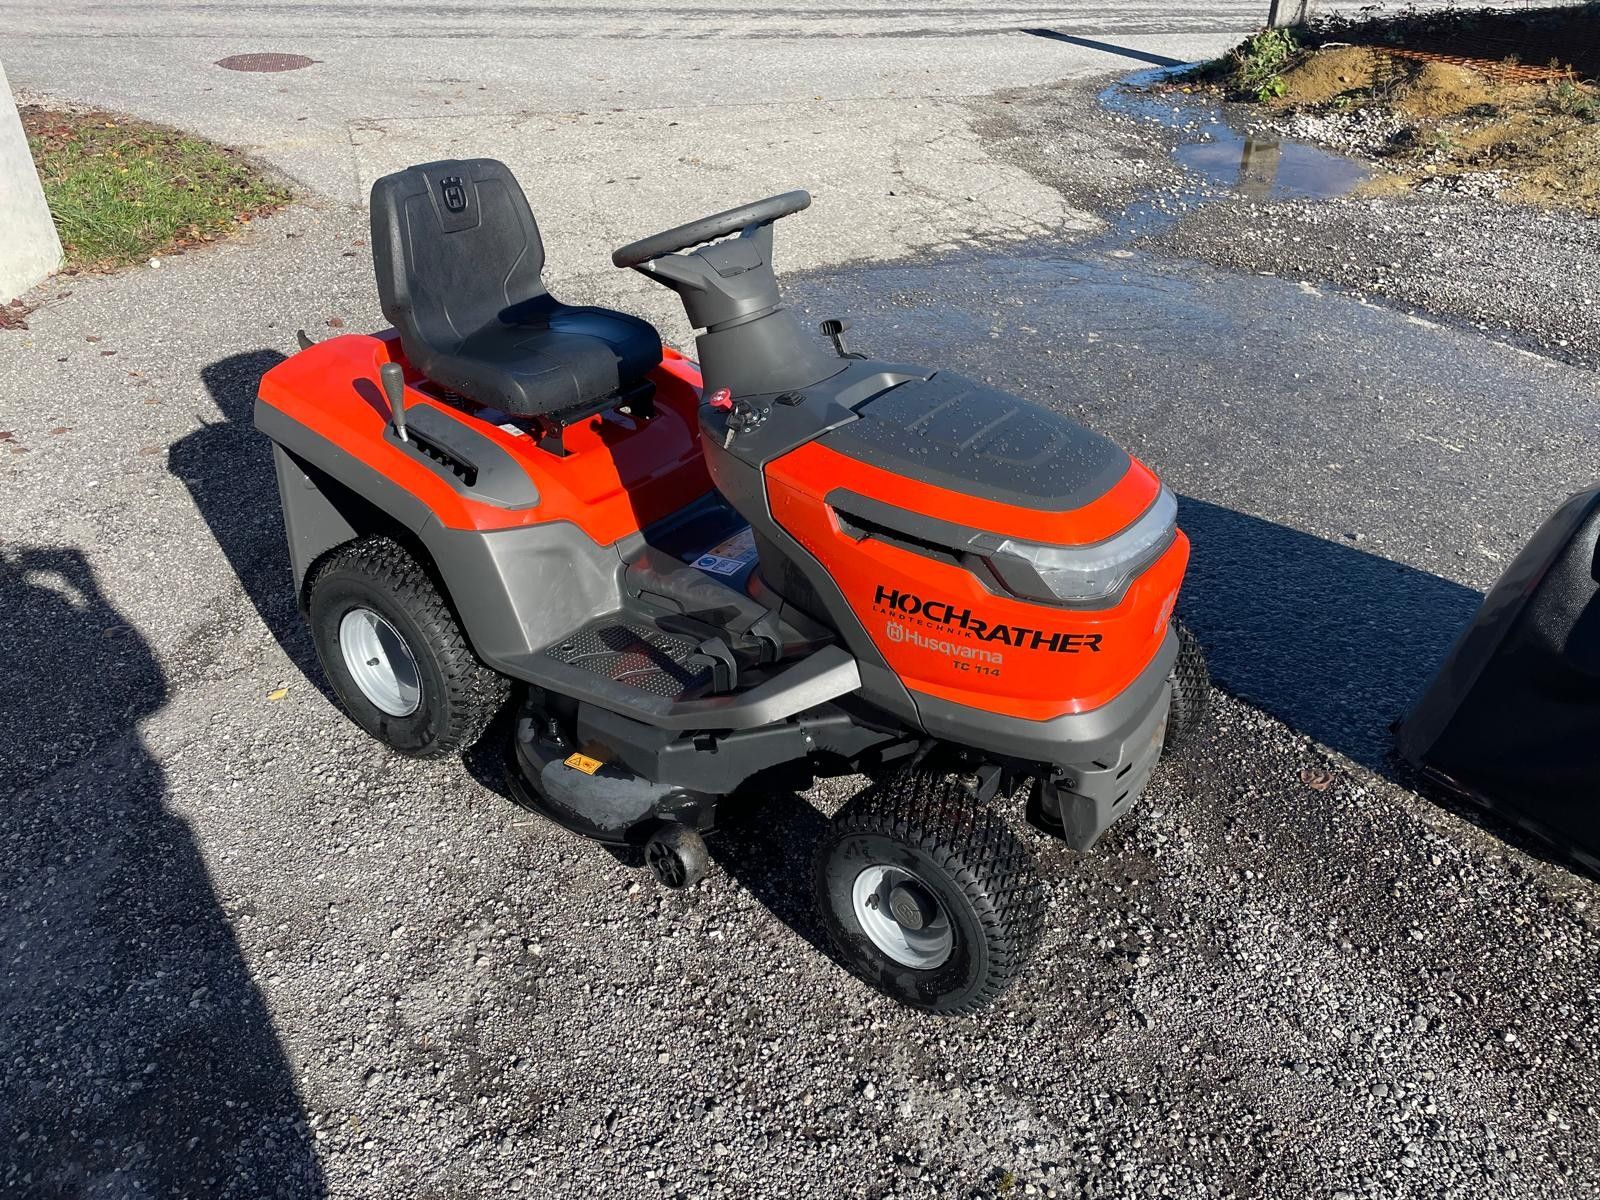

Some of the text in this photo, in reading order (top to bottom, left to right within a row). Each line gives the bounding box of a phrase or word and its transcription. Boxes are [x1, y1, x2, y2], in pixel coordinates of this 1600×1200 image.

[872, 605, 972, 638] LANDTECHNIK
[874, 585, 1103, 653] HOCHRATHER
[904, 628, 1003, 665] Husqvarna
[952, 660, 1001, 677] TC 114
